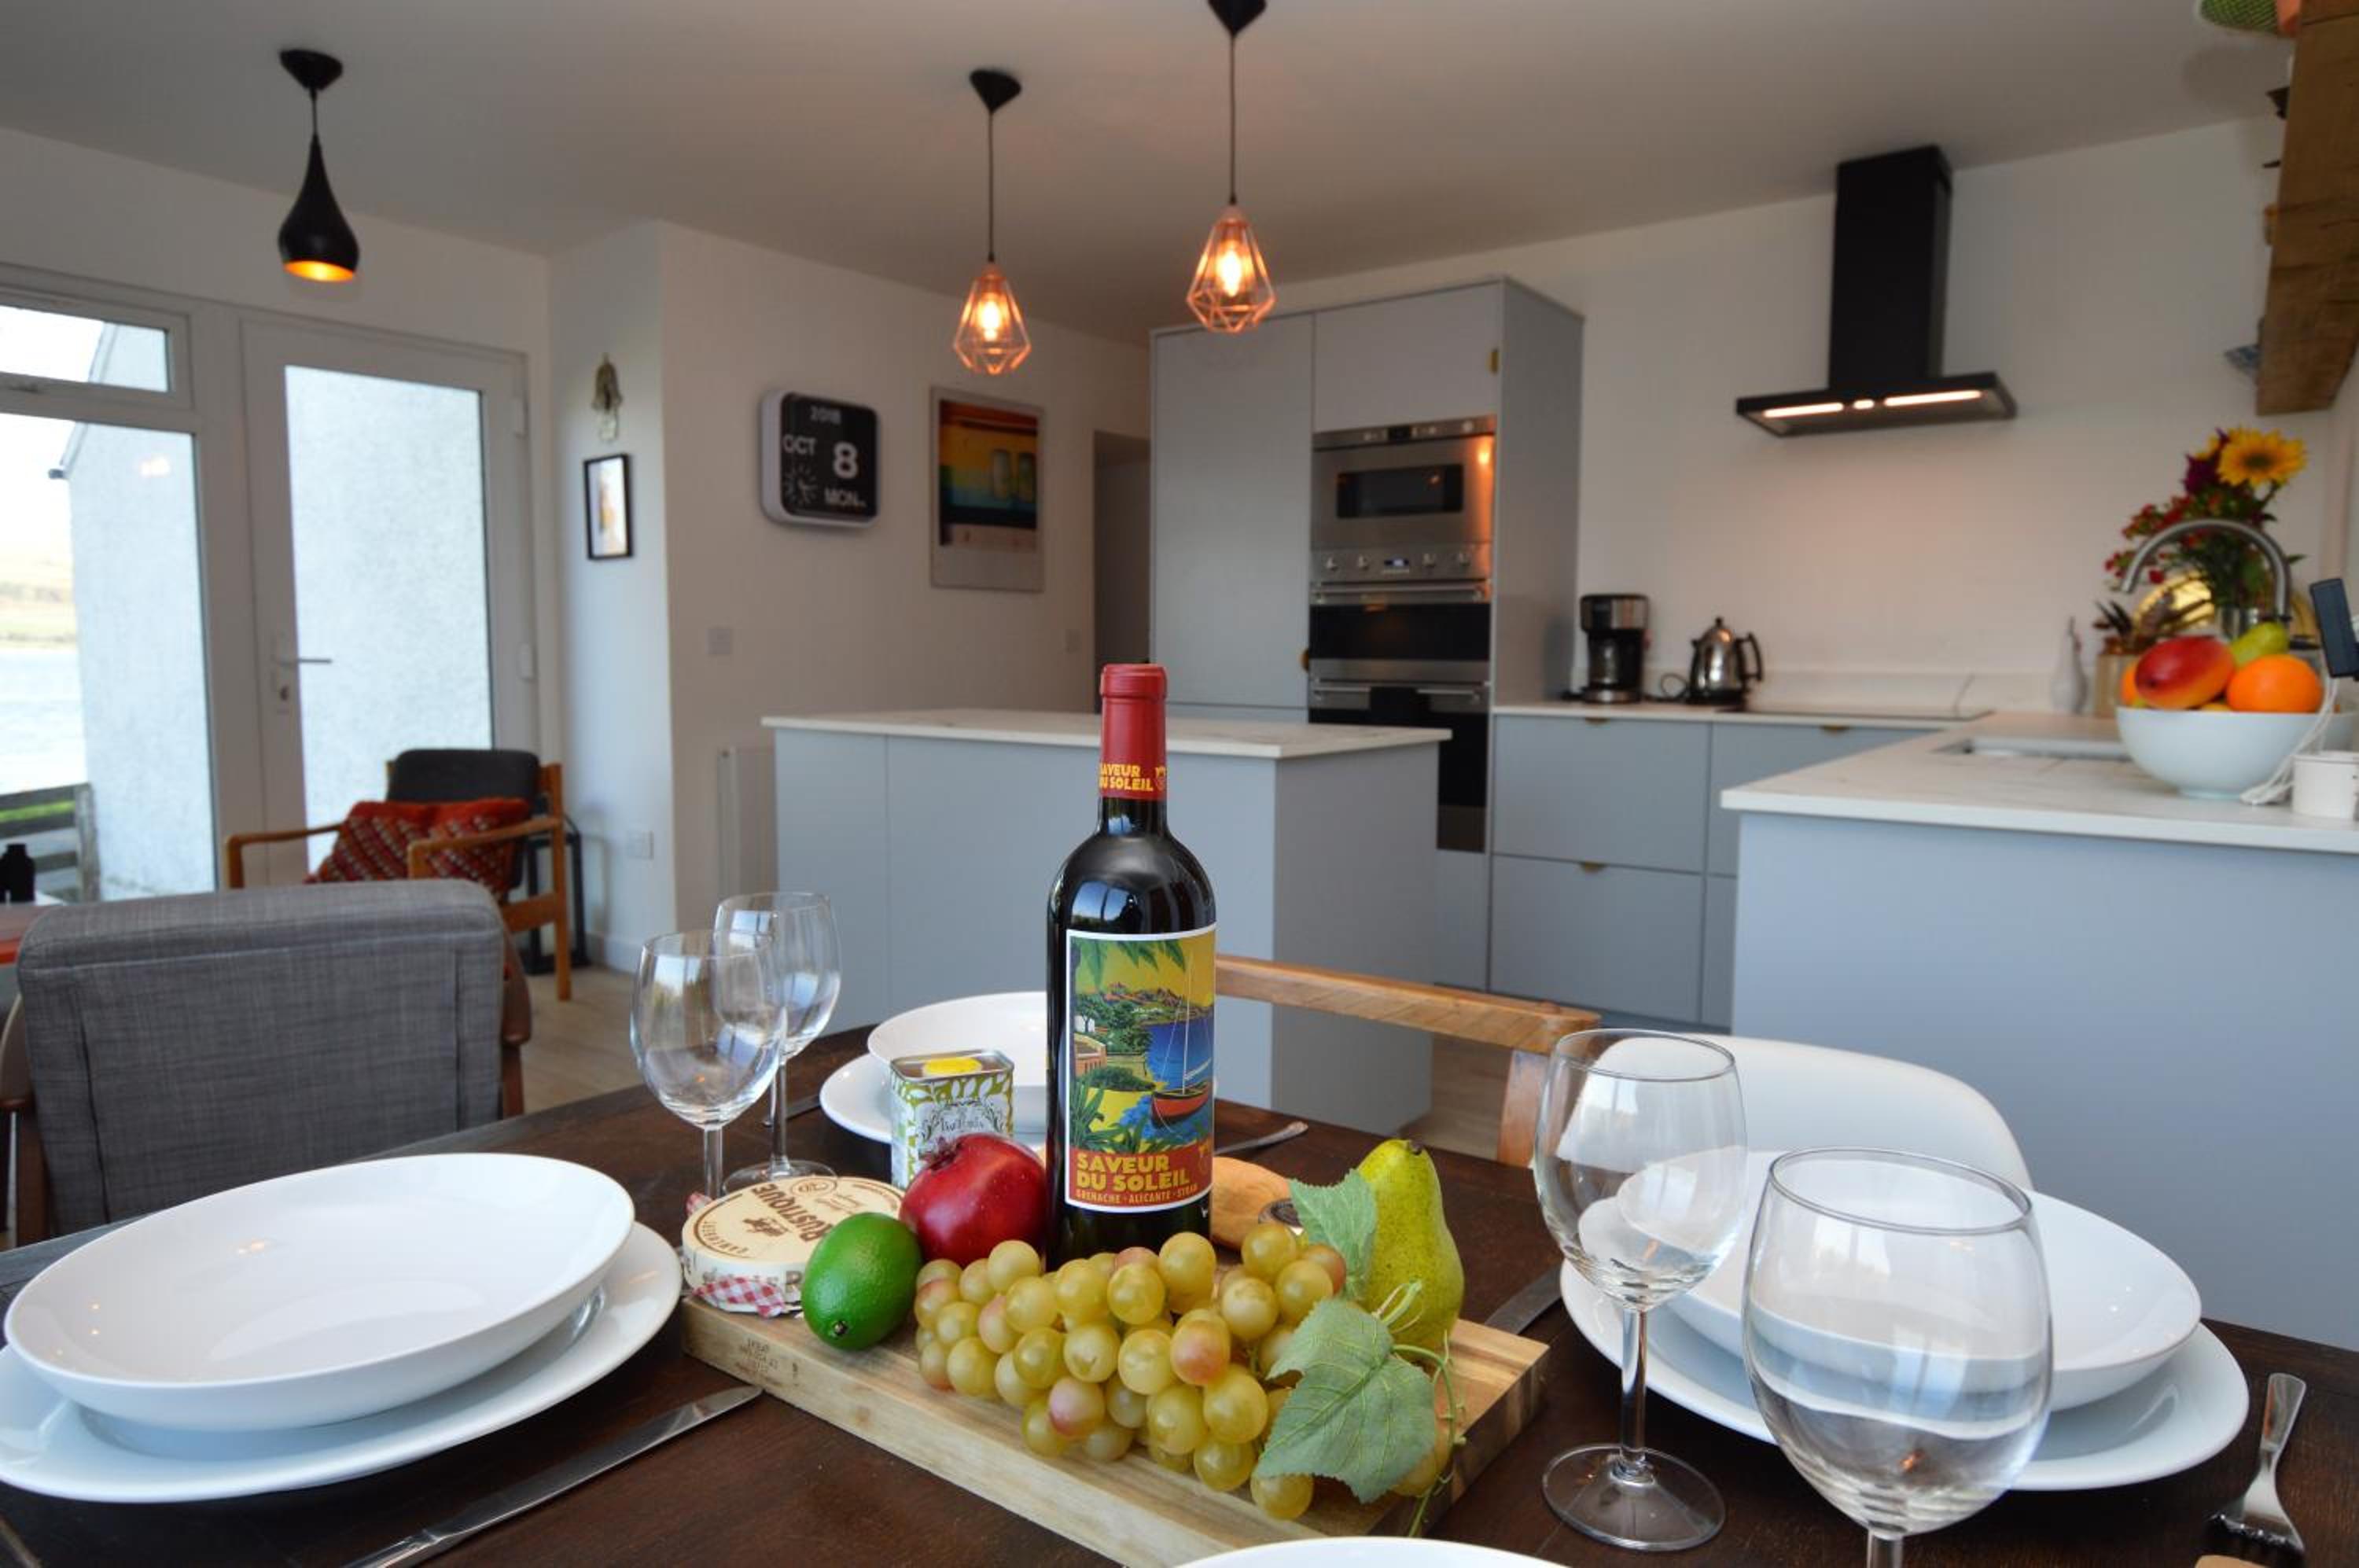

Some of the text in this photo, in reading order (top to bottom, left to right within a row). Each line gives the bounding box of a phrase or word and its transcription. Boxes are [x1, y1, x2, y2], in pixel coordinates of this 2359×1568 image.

[782, 434, 816, 455] OCT
[834, 442, 858, 479] 8
[1110, 777, 1154, 791] SOLEIL
[1077, 1154, 1169, 1174] SAVEUR
[1077, 1168, 1190, 1192] DU SOLEIL
[1075, 1188, 1121, 1204] GRENACHE
[1128, 1190, 1170, 1204] ALICANTE
[752, 1183, 835, 1242] RUSTIQUE
